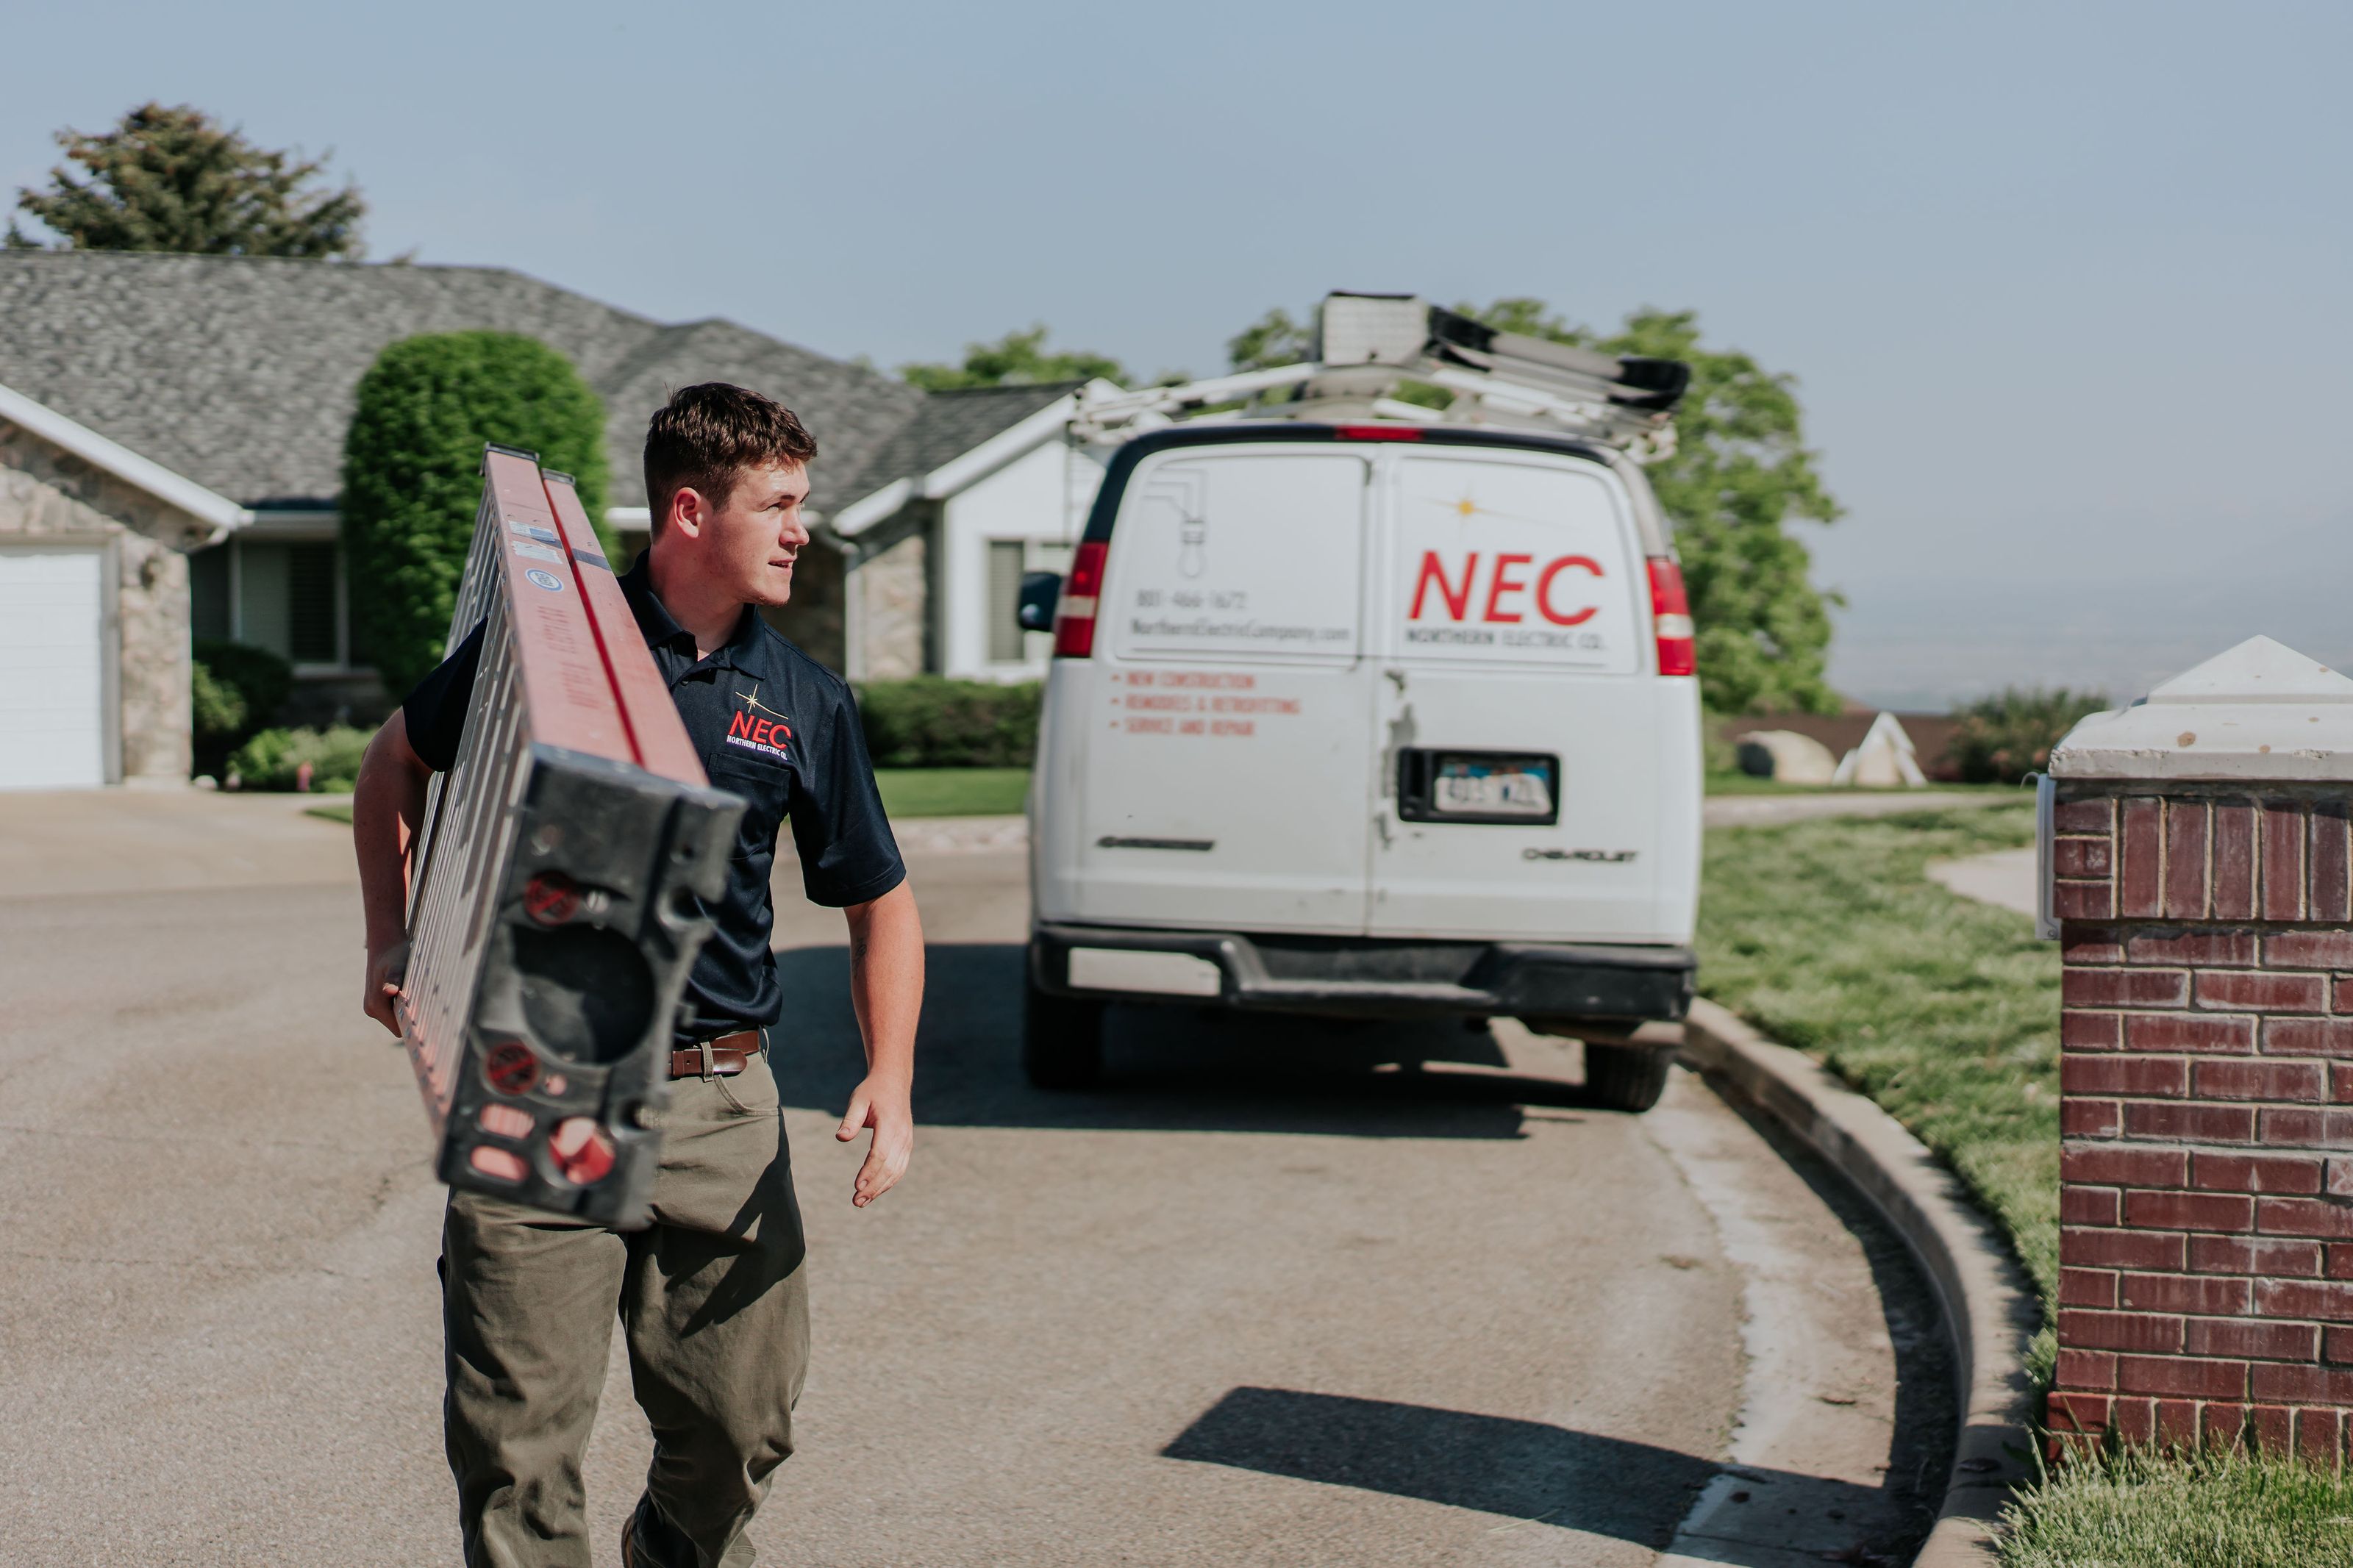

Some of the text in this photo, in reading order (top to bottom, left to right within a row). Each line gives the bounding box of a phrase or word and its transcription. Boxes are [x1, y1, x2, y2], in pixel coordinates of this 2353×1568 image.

[1407, 549, 1606, 626] NEC
[1407, 629, 1494, 645] NORTHERN
[1502, 631, 1572, 648] ELECTRIC
[1127, 671, 1154, 687] NEW
[729, 710, 792, 750] NEC
[726, 735, 757, 749] NORTHERN
[757, 743, 780, 756] ELECTRIC
